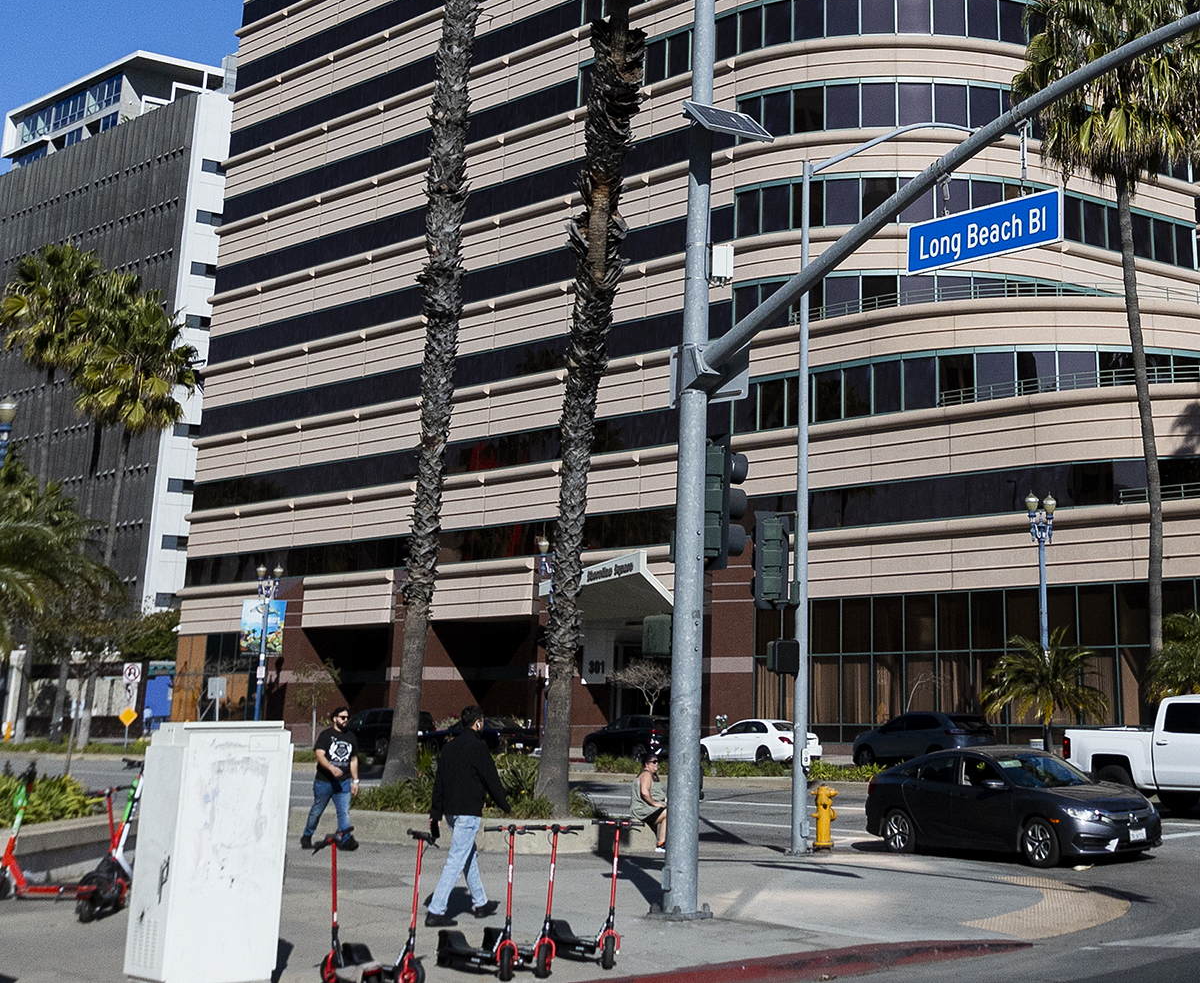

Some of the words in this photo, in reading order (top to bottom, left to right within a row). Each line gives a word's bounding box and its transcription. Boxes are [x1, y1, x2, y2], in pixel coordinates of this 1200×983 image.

[919, 233, 962, 261] Long
[967, 213, 1023, 249] Beach
[1029, 205, 1047, 235] Bl
[588, 660, 606, 675] 301
